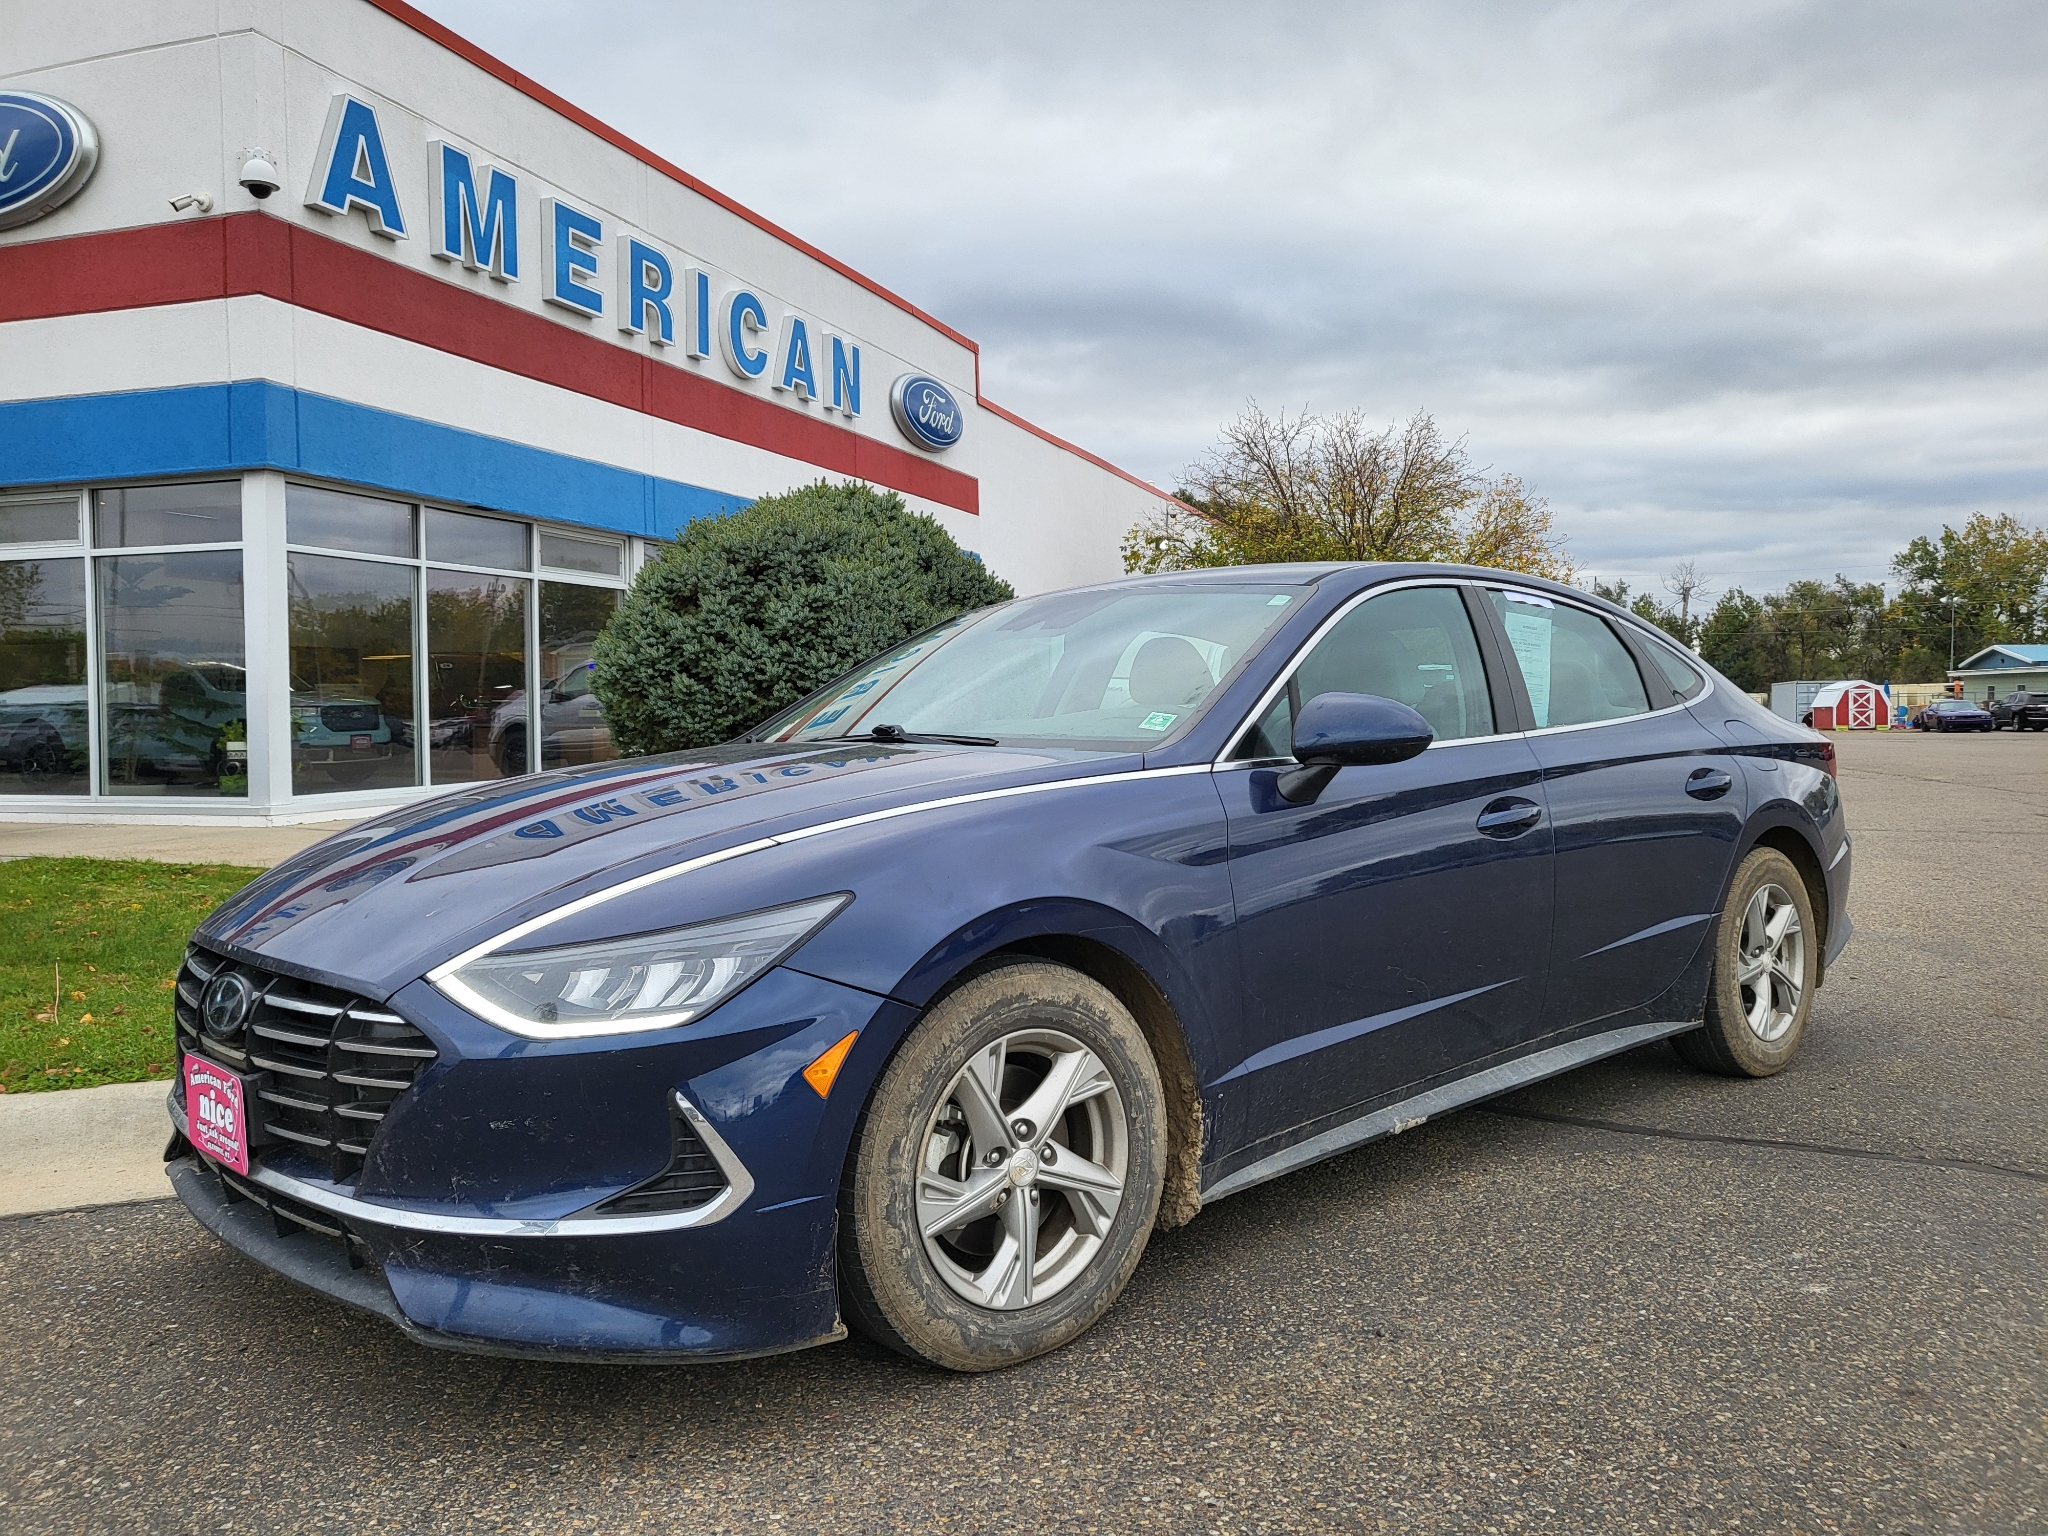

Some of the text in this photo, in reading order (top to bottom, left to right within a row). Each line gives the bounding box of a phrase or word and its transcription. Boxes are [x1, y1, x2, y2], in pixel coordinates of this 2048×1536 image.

[306, 93, 862, 418] AMERICAN
[918, 388, 955, 435] Ford
[190, 1071, 239, 1109] American Ford
[199, 1089, 234, 1133] nice
[196, 1120, 208, 1133] Just
